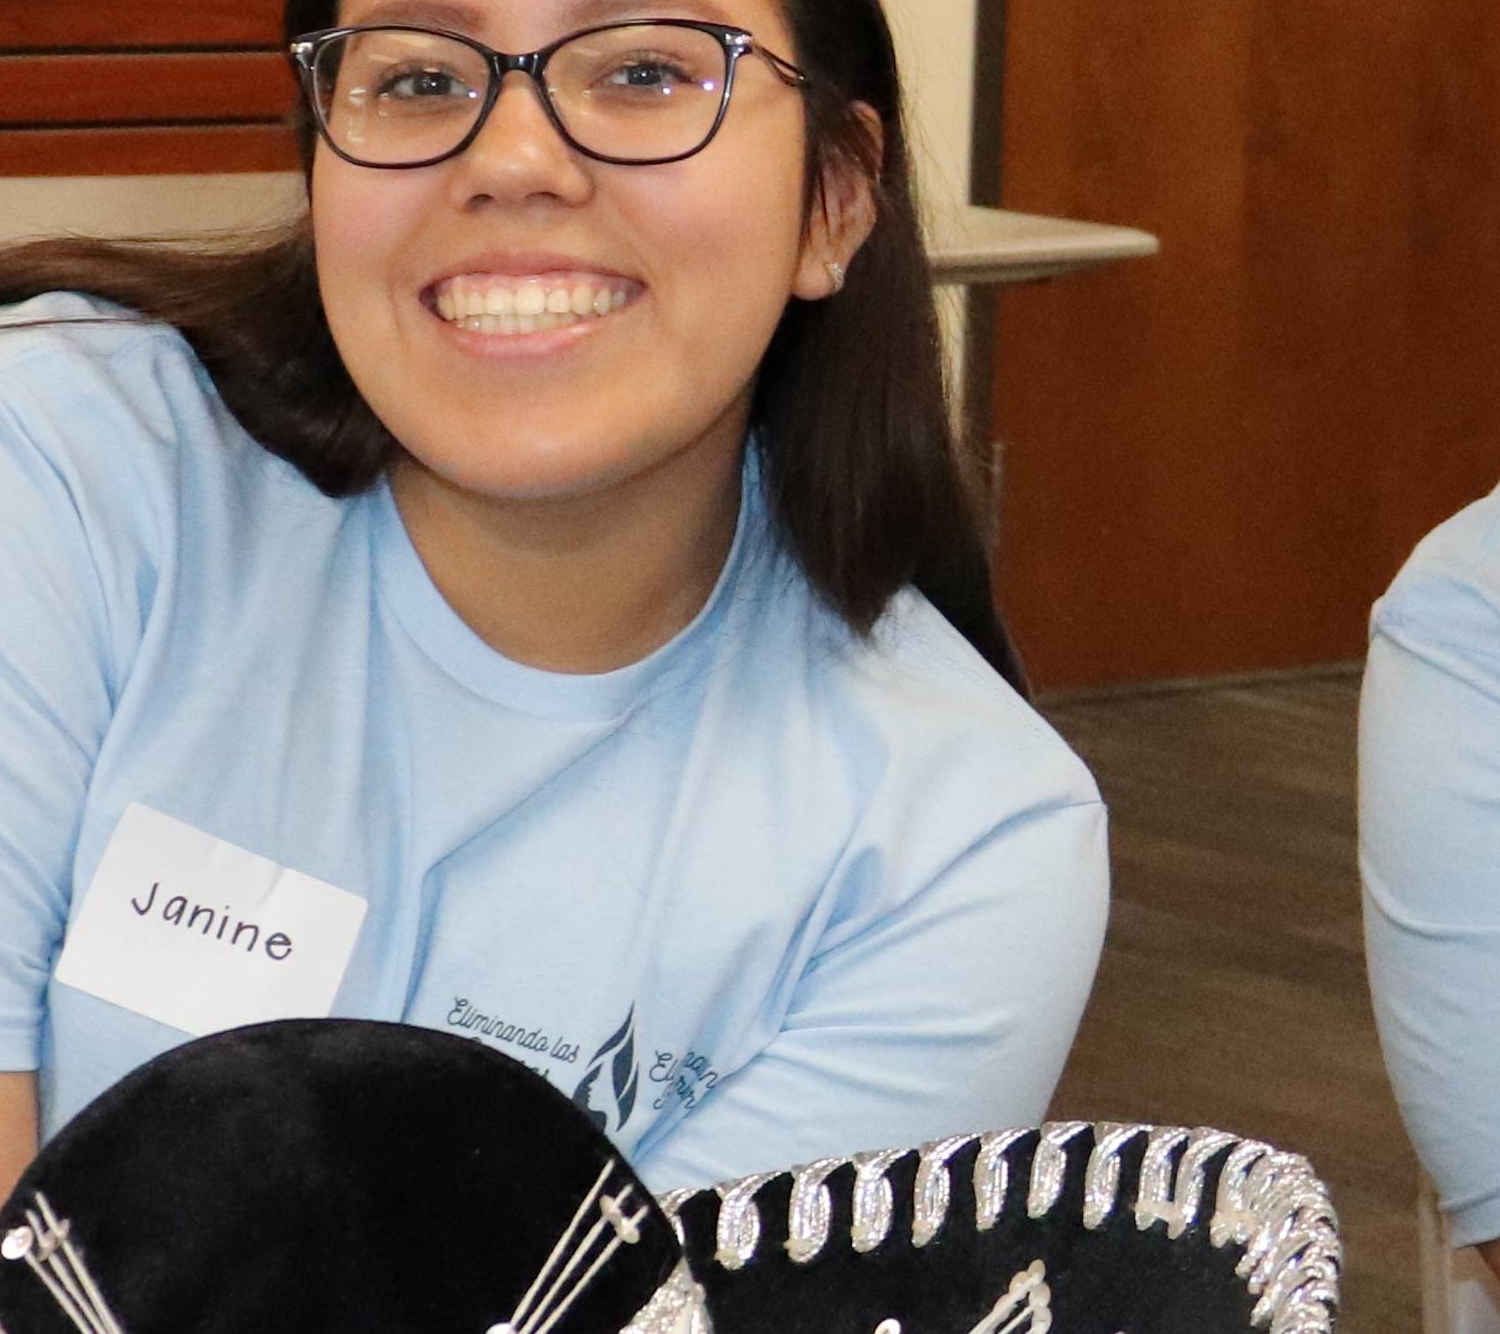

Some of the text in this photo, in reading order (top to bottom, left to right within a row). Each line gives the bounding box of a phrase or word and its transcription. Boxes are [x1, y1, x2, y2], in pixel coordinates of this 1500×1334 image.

[130, 881, 293, 961] Janine
[447, 996, 581, 1064] Eliminando las
